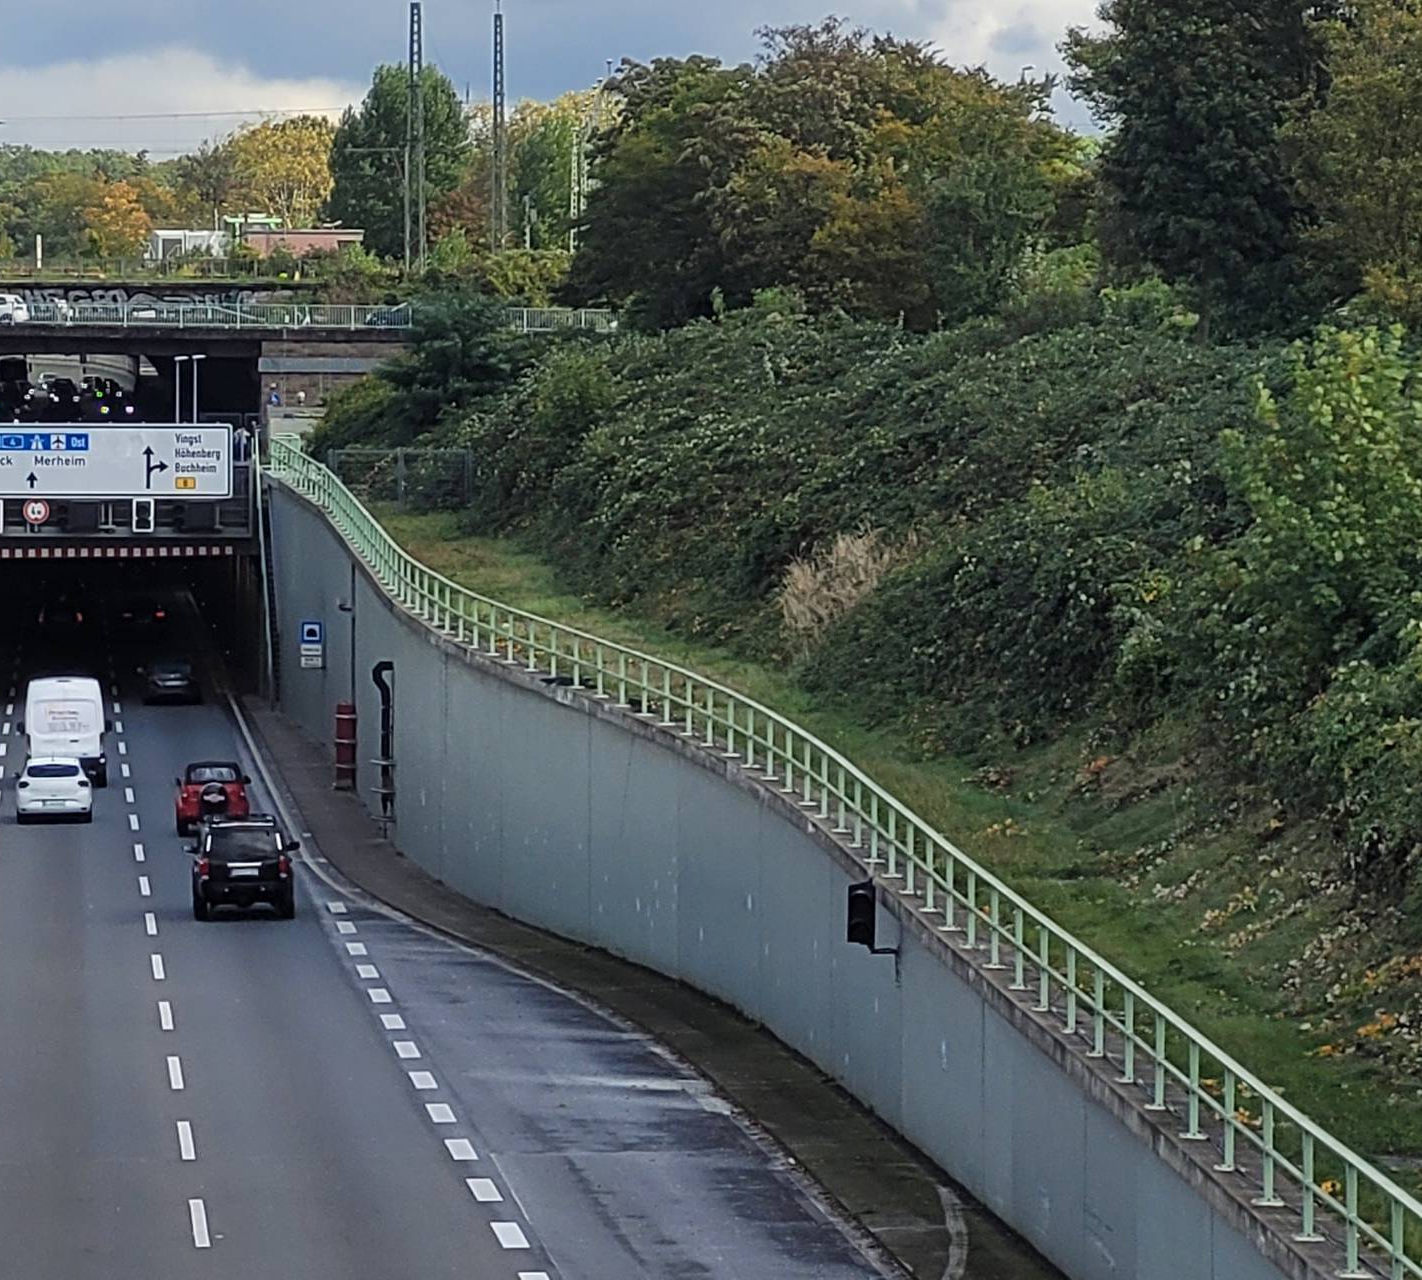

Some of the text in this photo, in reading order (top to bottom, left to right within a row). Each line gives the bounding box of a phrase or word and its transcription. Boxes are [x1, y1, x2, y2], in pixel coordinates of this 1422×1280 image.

[71, 436, 86, 447] Ost
[175, 433, 201, 446] Vingst
[175, 448, 220, 461] Höhenberg
[34, 455, 86, 466] Merheim
[175, 462, 216, 472] Buchheim
